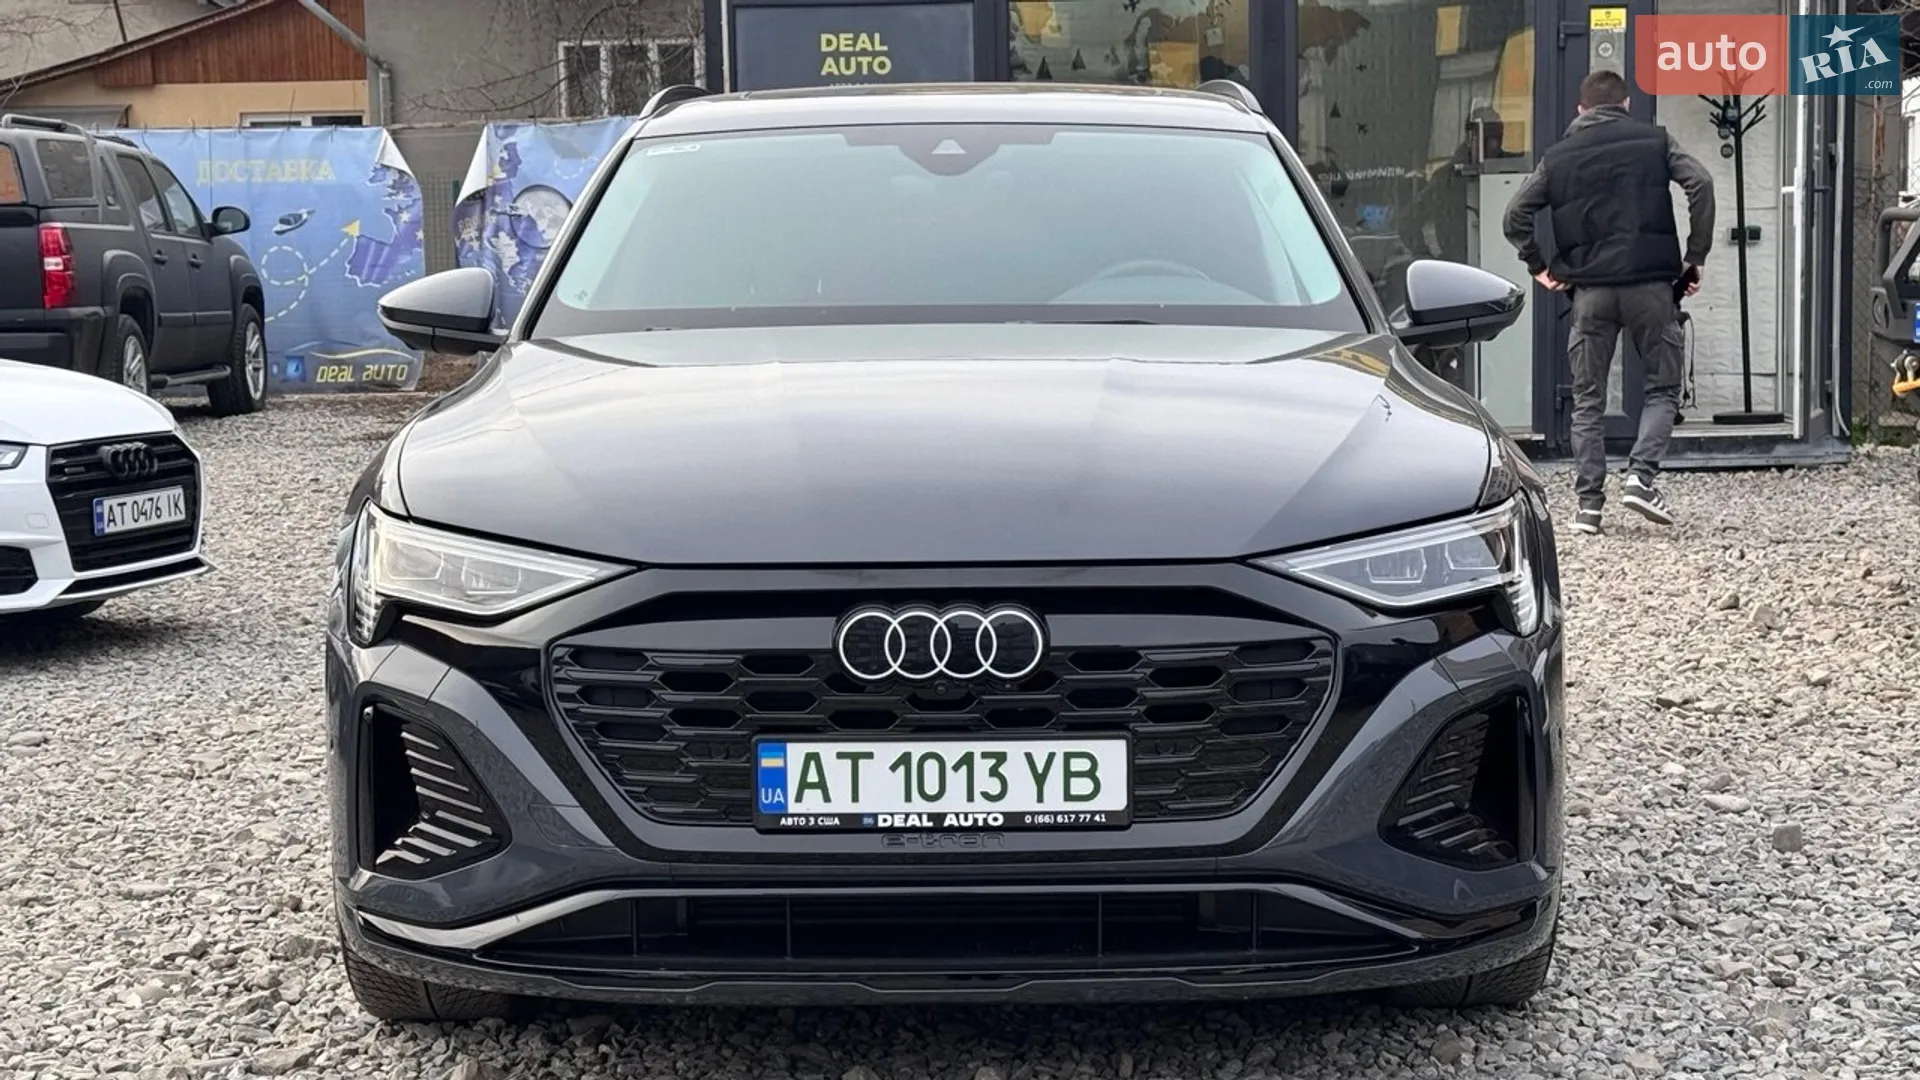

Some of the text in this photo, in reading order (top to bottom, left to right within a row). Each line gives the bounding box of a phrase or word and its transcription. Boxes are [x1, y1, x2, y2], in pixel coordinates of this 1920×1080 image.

[820, 32, 888, 52] DEAL
[820, 56, 892, 76] AUTO
[196, 159, 336, 187] ДОСТАВКА
[106, 492, 183, 527] AT 0476 IK
[794, 750, 1101, 803] AT 1013 YB
[761, 788, 785, 804] UA
[780, 817, 805, 826] АВТО
[818, 816, 840, 825] США
[877, 814, 933, 827] DEAL
[943, 813, 1004, 827] AUTO
[1034, 814, 1054, 824] (66)
[1057, 814, 1075, 823] 617
[1078, 814, 1091, 823] 77
[1094, 813, 1106, 822] 41
[881, 833, 1005, 848] e-tron
